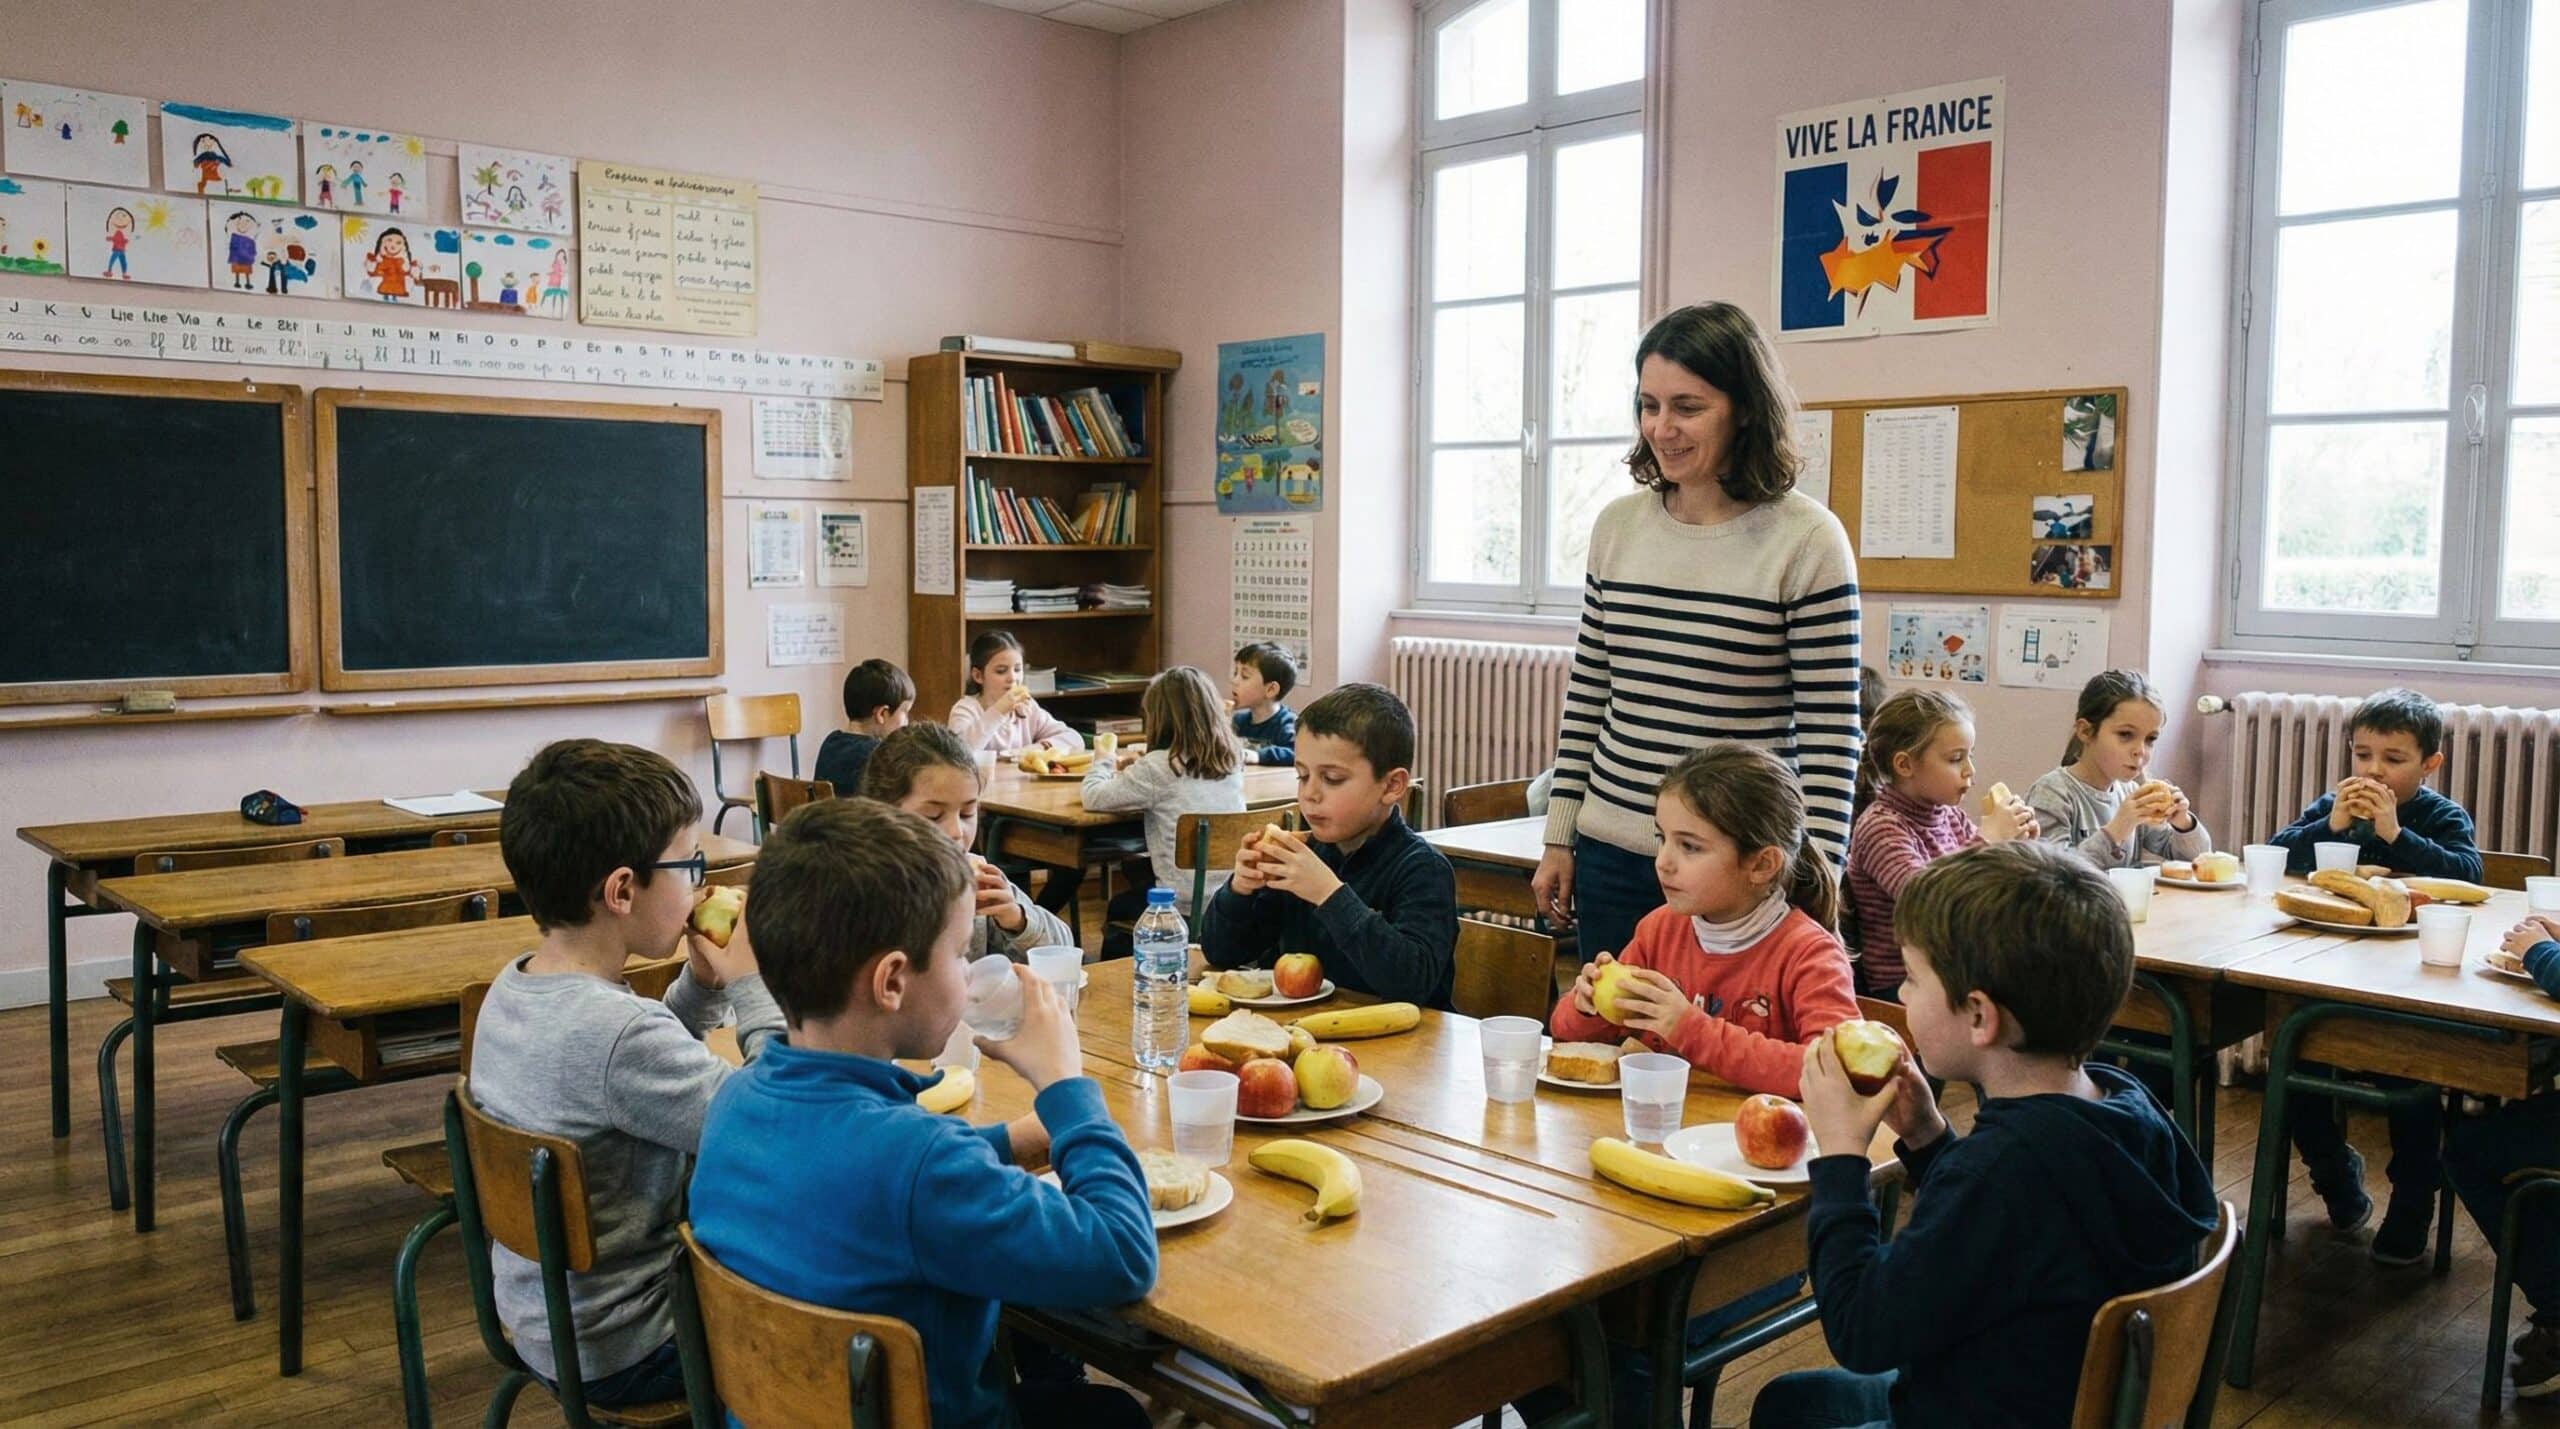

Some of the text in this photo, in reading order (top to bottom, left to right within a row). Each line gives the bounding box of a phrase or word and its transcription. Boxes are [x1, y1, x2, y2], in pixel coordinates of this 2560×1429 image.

[1786, 95, 1993, 159] VIVE LA FRANCE
[45, 303, 57, 316] K
